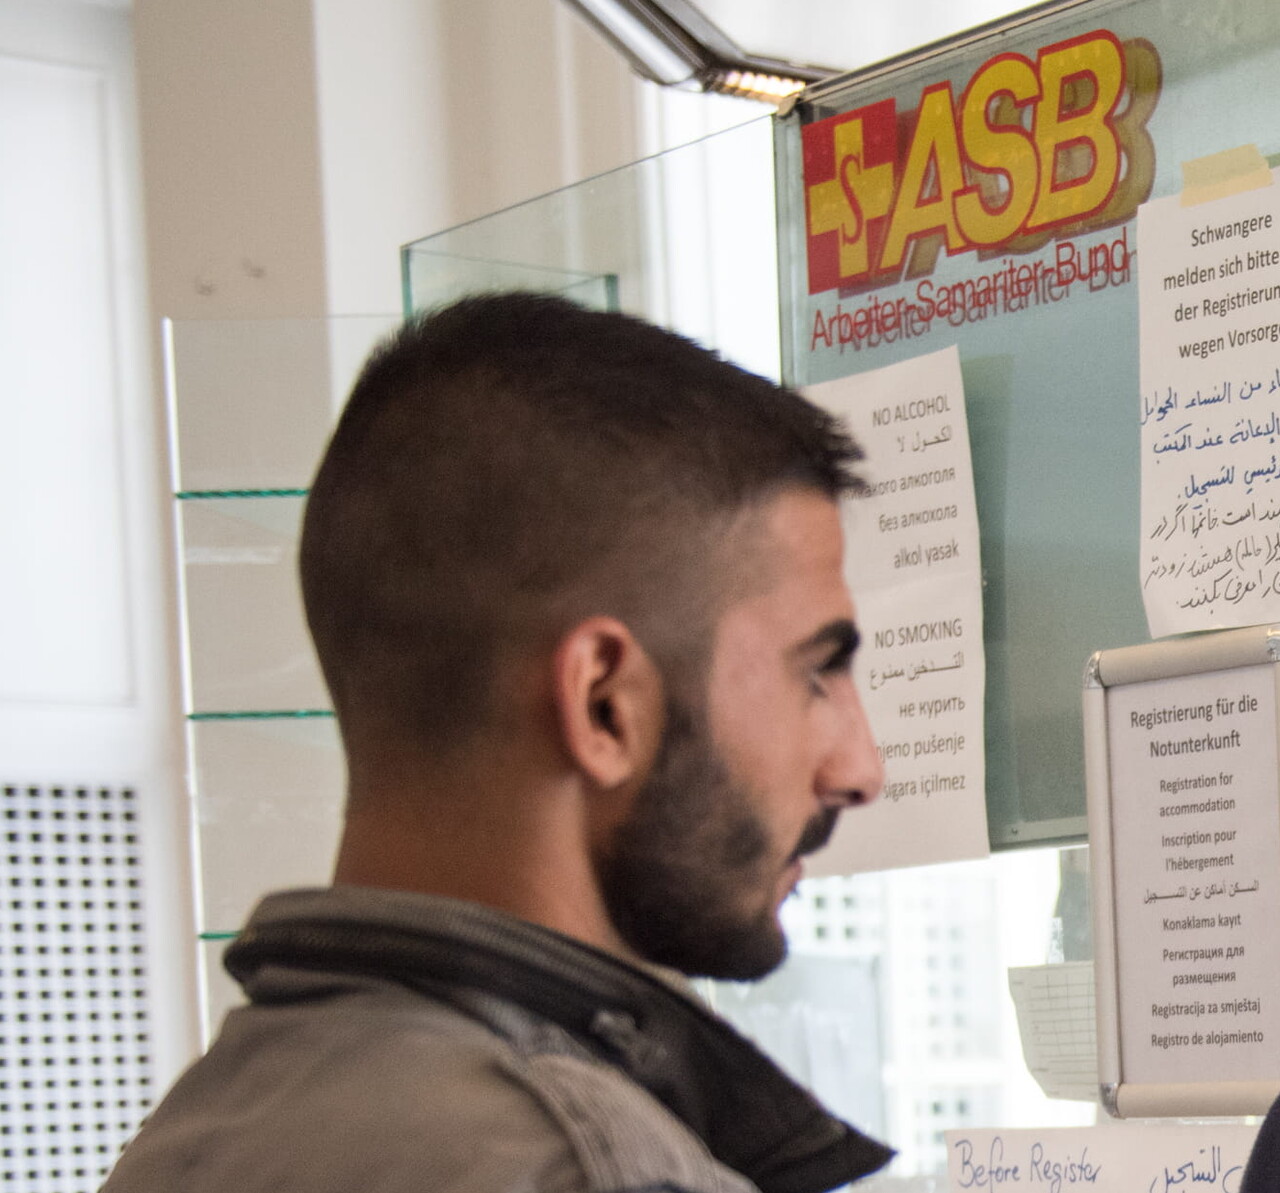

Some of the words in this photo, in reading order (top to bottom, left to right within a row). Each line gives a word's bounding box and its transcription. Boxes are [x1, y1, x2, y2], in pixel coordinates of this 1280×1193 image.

[880, 28, 1127, 271] ASB
[1191, 213, 1273, 247] Schwangere
[1163, 267, 1216, 291] melden
[1219, 256, 1243, 279] sich
[1247, 250, 1280, 271] bitte
[811, 227, 1128, 350] Arbeiter-Samariter-Bund
[1174, 303, 1198, 322] der
[1179, 336, 1224, 360] wegen
[1240, 381, 1262, 400] من
[872, 409, 891, 428] NO
[895, 396, 951, 422] ALCOHOL
[1153, 423, 1192, 465] المكتب
[1196, 427, 1223, 450] عند
[900, 467, 956, 489] алкоголя
[878, 514, 898, 532] без
[894, 545, 921, 569] alkol
[926, 539, 960, 566] yasak
[874, 630, 895, 649] NO
[898, 618, 963, 647] SMOKING
[899, 702, 916, 718] не
[919, 696, 966, 719] курить
[1131, 705, 1213, 730] Registrierung
[1216, 698, 1235, 715] für
[1238, 694, 1258, 713] die
[914, 732, 965, 760] pušenje
[1150, 730, 1241, 758] Notunterkunft
[883, 779, 917, 802] sigara
[920, 772, 965, 798] içilmez
[1160, 774, 1217, 794] Registration
[1220, 772, 1234, 787] for
[1160, 798, 1236, 817] accommodation
[1162, 830, 1212, 848] Inscription
[1214, 829, 1237, 845] pour
[1166, 853, 1235, 872] l'hébergement
[1218, 913, 1242, 930] kayıt
[1163, 948, 1224, 963] Регистрация
[1226, 946, 1245, 959] для
[1173, 970, 1236, 988] размещения
[1152, 1002, 1205, 1019] Registracija
[1208, 1004, 1218, 1014] za
[1220, 998, 1261, 1016] smještaj
[1151, 1033, 1189, 1050] Registro
[1192, 1031, 1203, 1045] de
[1206, 1029, 1264, 1047] alojamiento
[954, 1136, 1021, 1193] Before
[1029, 1142, 1105, 1193] Register
